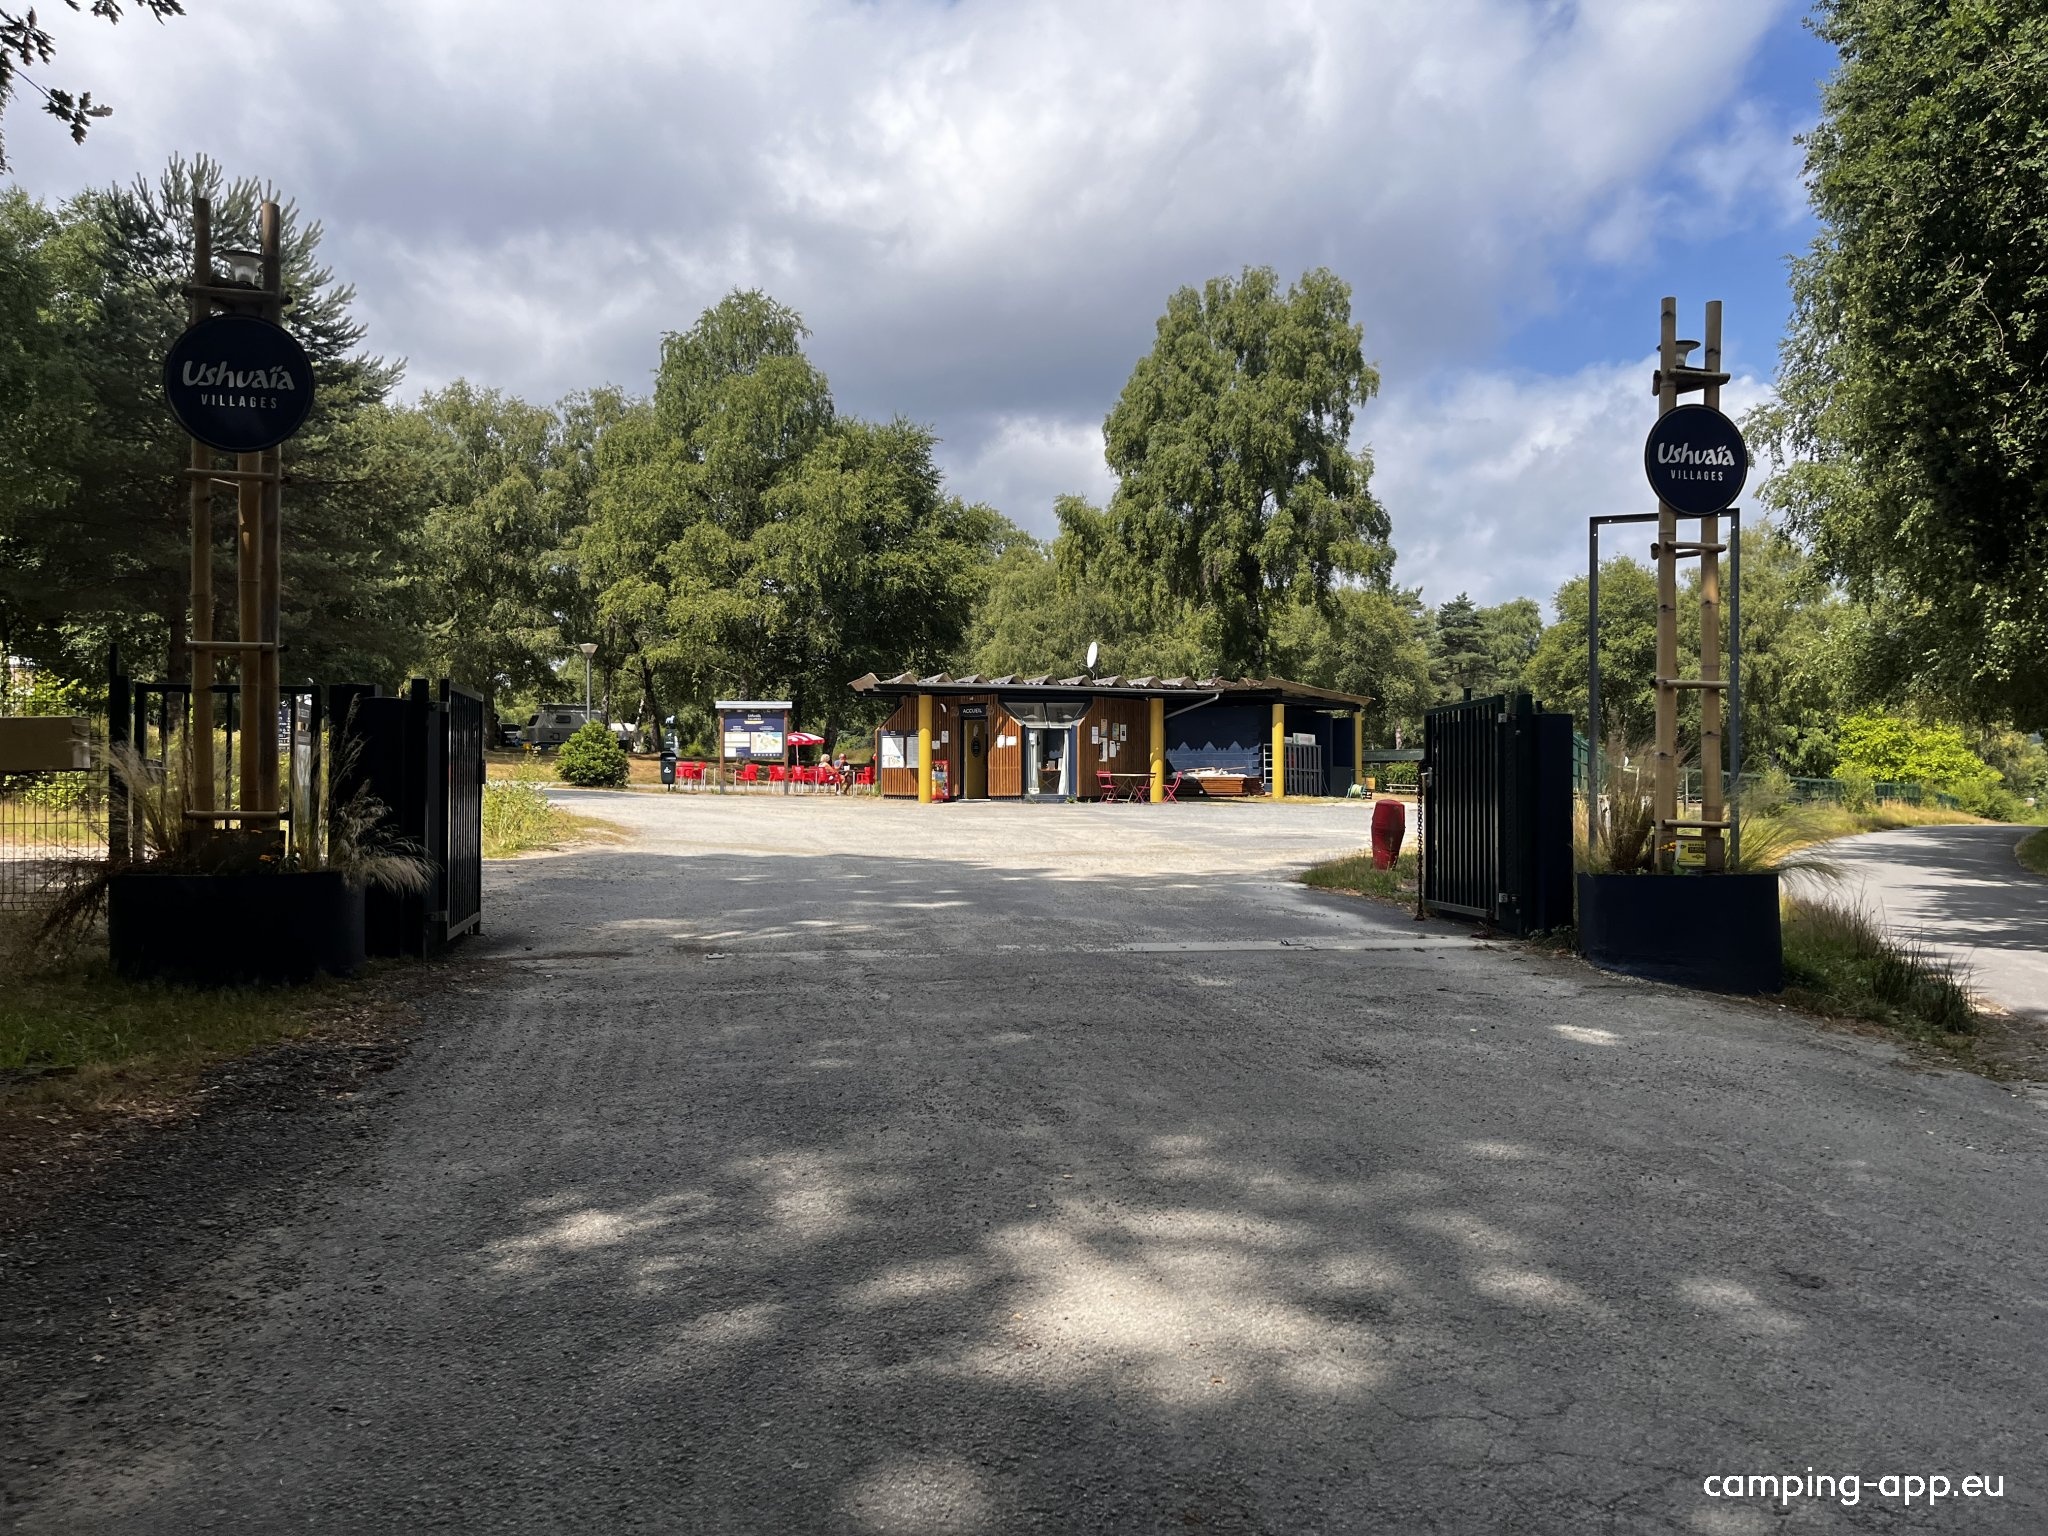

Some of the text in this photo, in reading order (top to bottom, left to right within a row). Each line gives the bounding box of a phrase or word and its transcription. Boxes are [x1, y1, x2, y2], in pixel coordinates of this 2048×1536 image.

[182, 360, 295, 390] Ushuaïa
[201, 393, 277, 409] VILLAGES
[1657, 442, 1735, 466] Ushuaïa
[1670, 469, 1723, 481] VILLAGES
